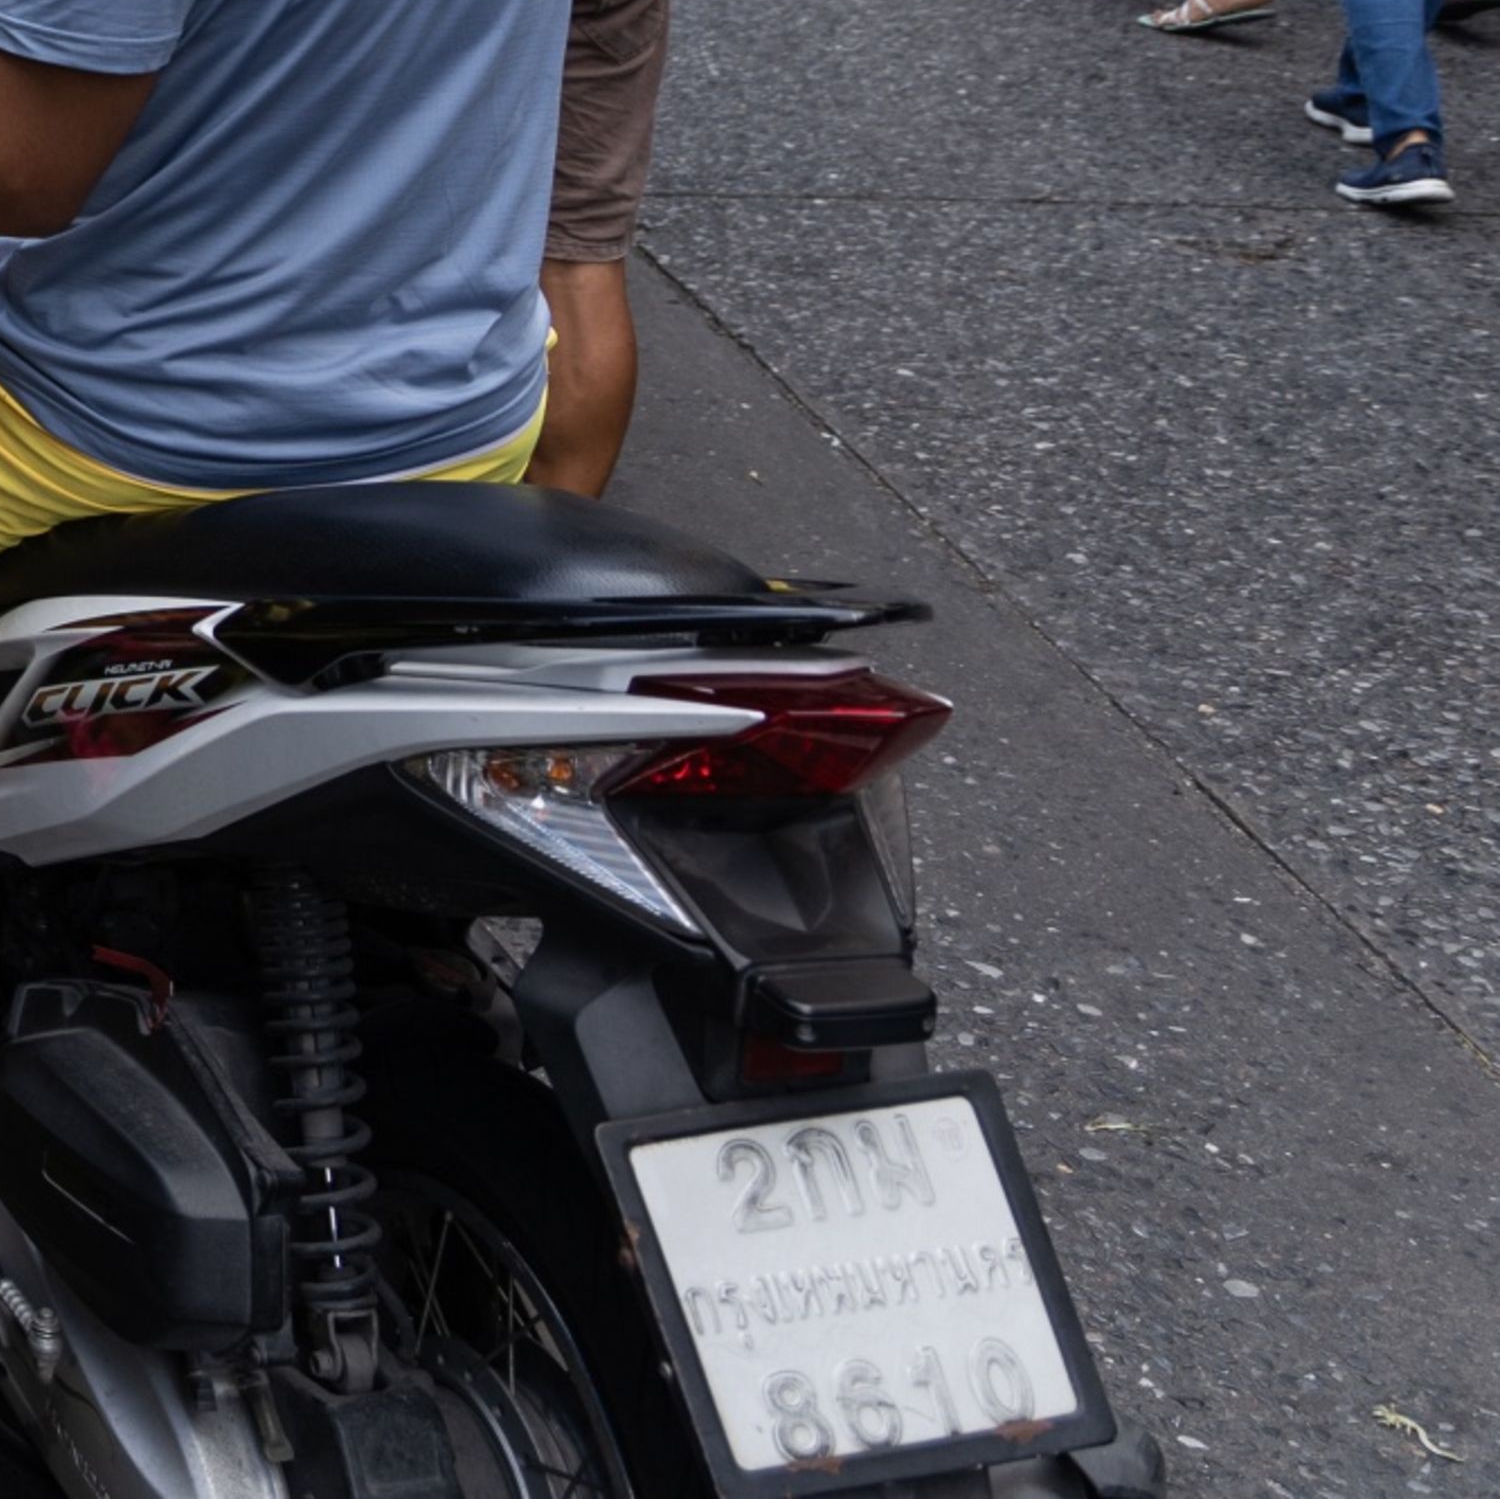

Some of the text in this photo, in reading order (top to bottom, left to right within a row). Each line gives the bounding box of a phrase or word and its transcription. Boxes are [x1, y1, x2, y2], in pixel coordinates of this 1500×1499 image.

[23, 668, 202, 724] CLICK
[683, 1235, 1037, 1350] กรุงเทพมหานคร
[763, 1335, 1037, 1462] 8610
